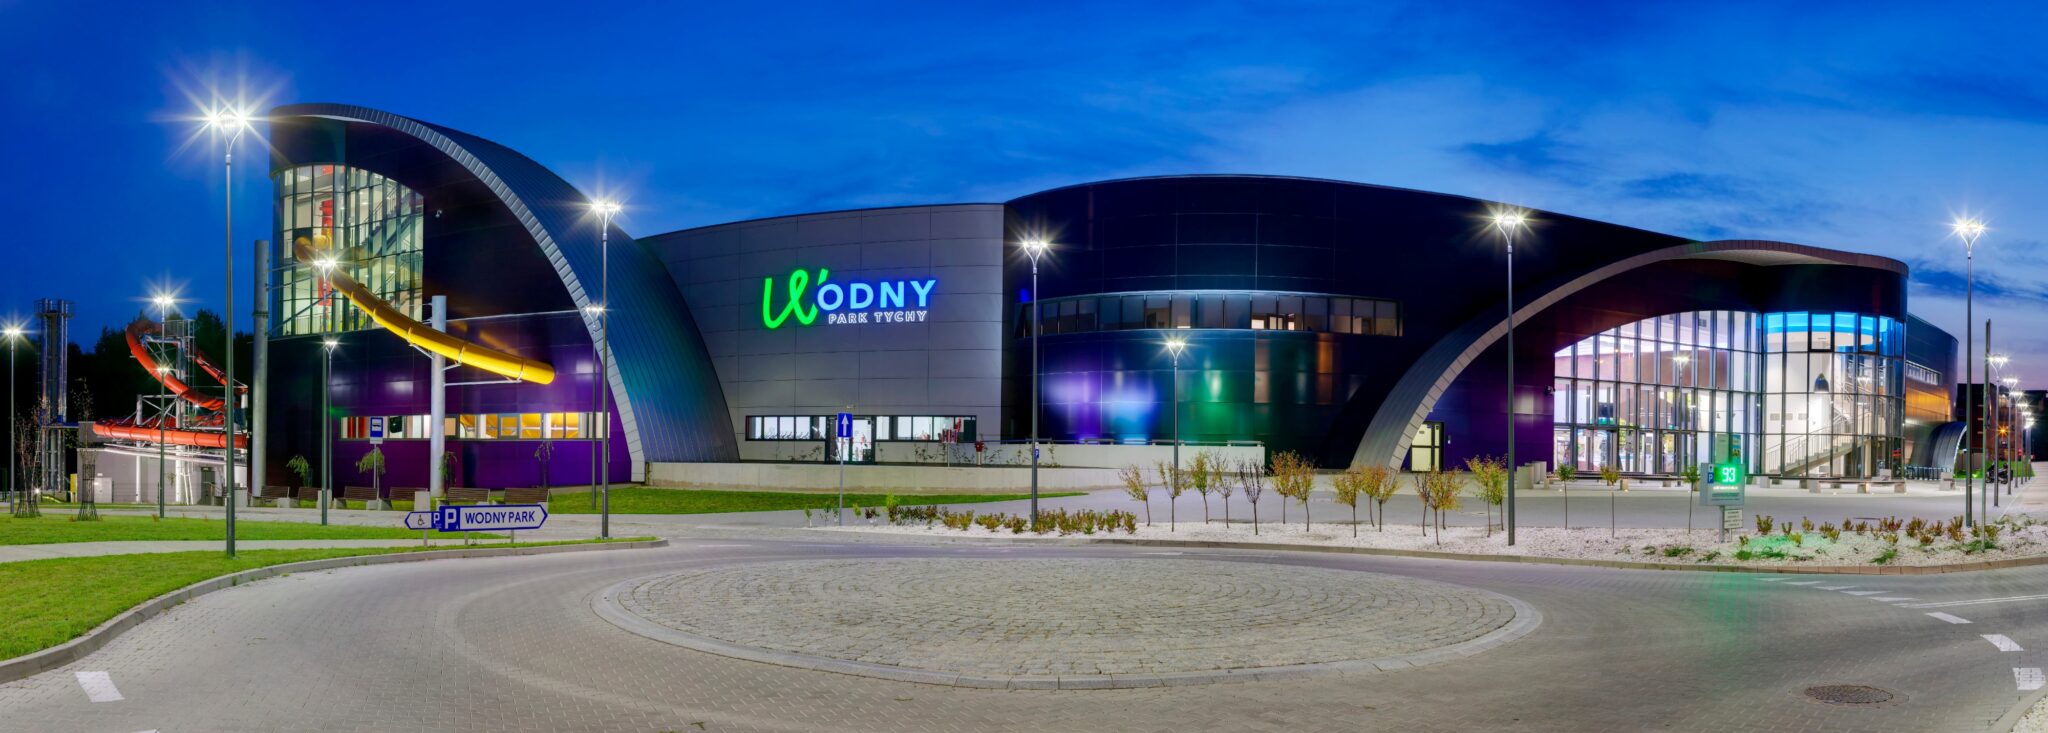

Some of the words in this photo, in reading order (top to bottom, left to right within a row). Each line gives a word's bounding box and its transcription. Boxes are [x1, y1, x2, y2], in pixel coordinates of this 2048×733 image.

[828, 312, 868, 325] PARK
[874, 310, 928, 323] TYCHY
[1722, 467, 1736, 482] 93
[433, 512, 440, 524] P
[444, 508, 457, 529] P
[465, 512, 507, 524] WODNY
[508, 511, 535, 523] PARK
